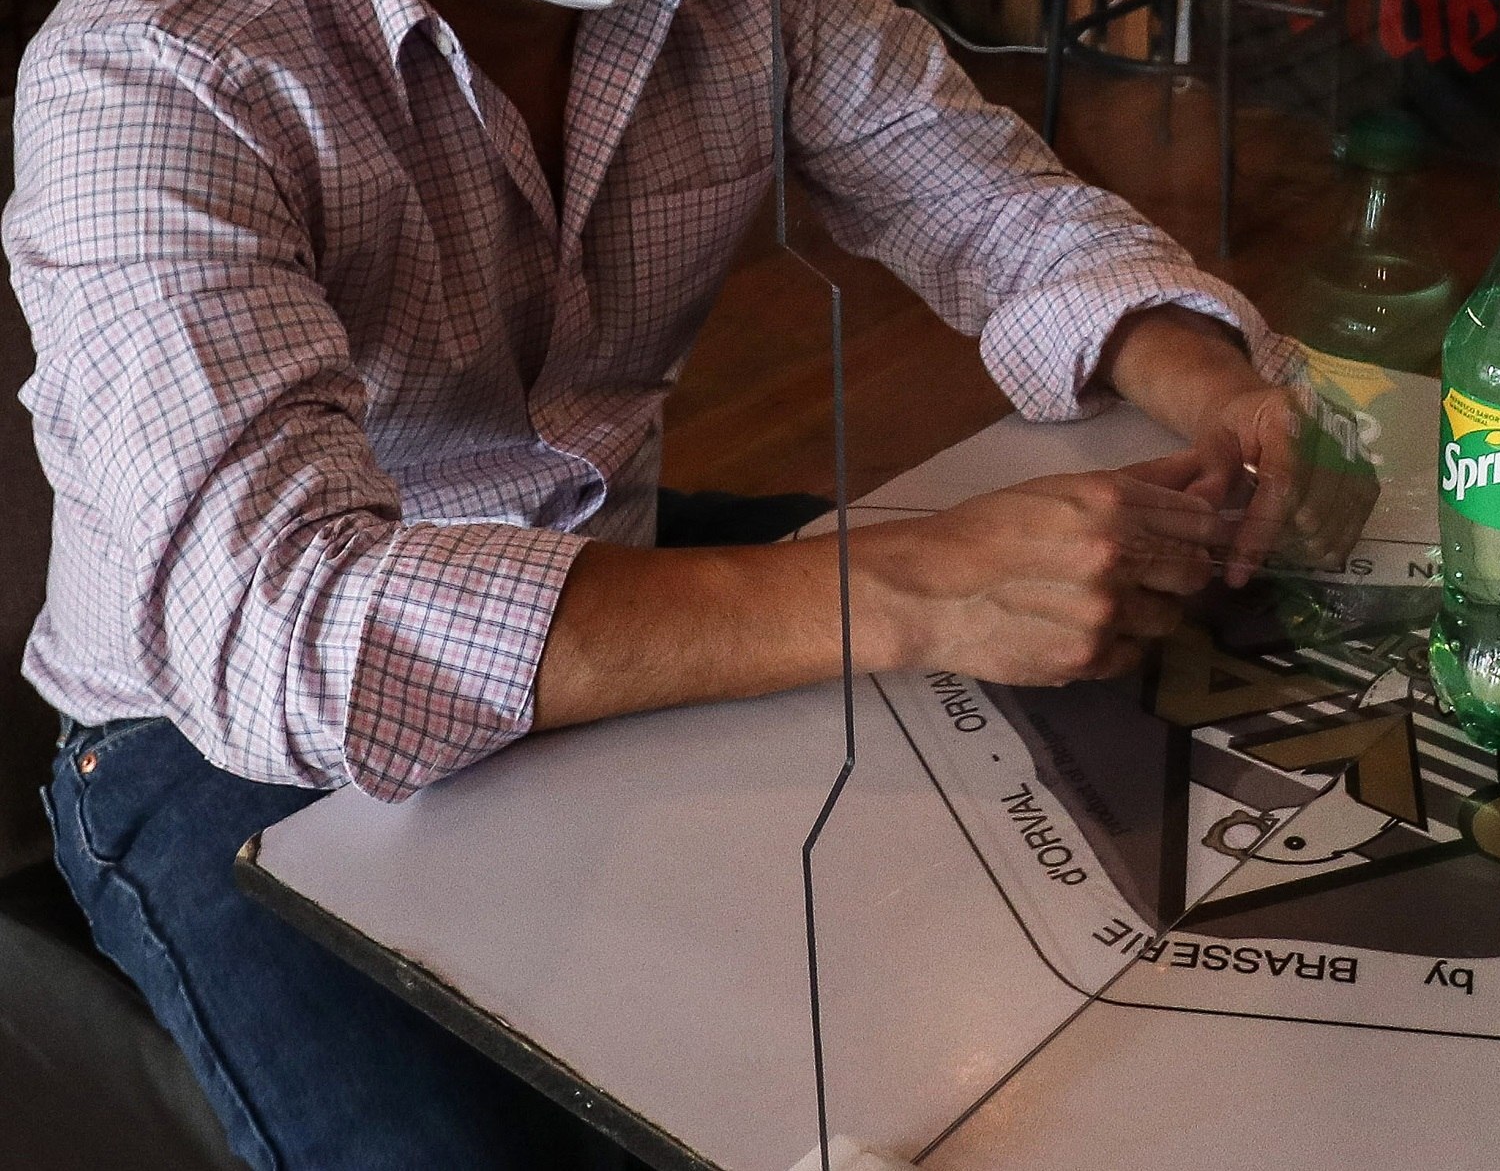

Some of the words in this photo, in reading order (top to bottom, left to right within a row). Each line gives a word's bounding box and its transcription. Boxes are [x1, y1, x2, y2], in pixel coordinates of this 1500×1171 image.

[1001, 782, 1088, 886] d'ORVAL
[1092, 917, 1358, 984] BRASSERIE
[1424, 959, 1474, 995] by
